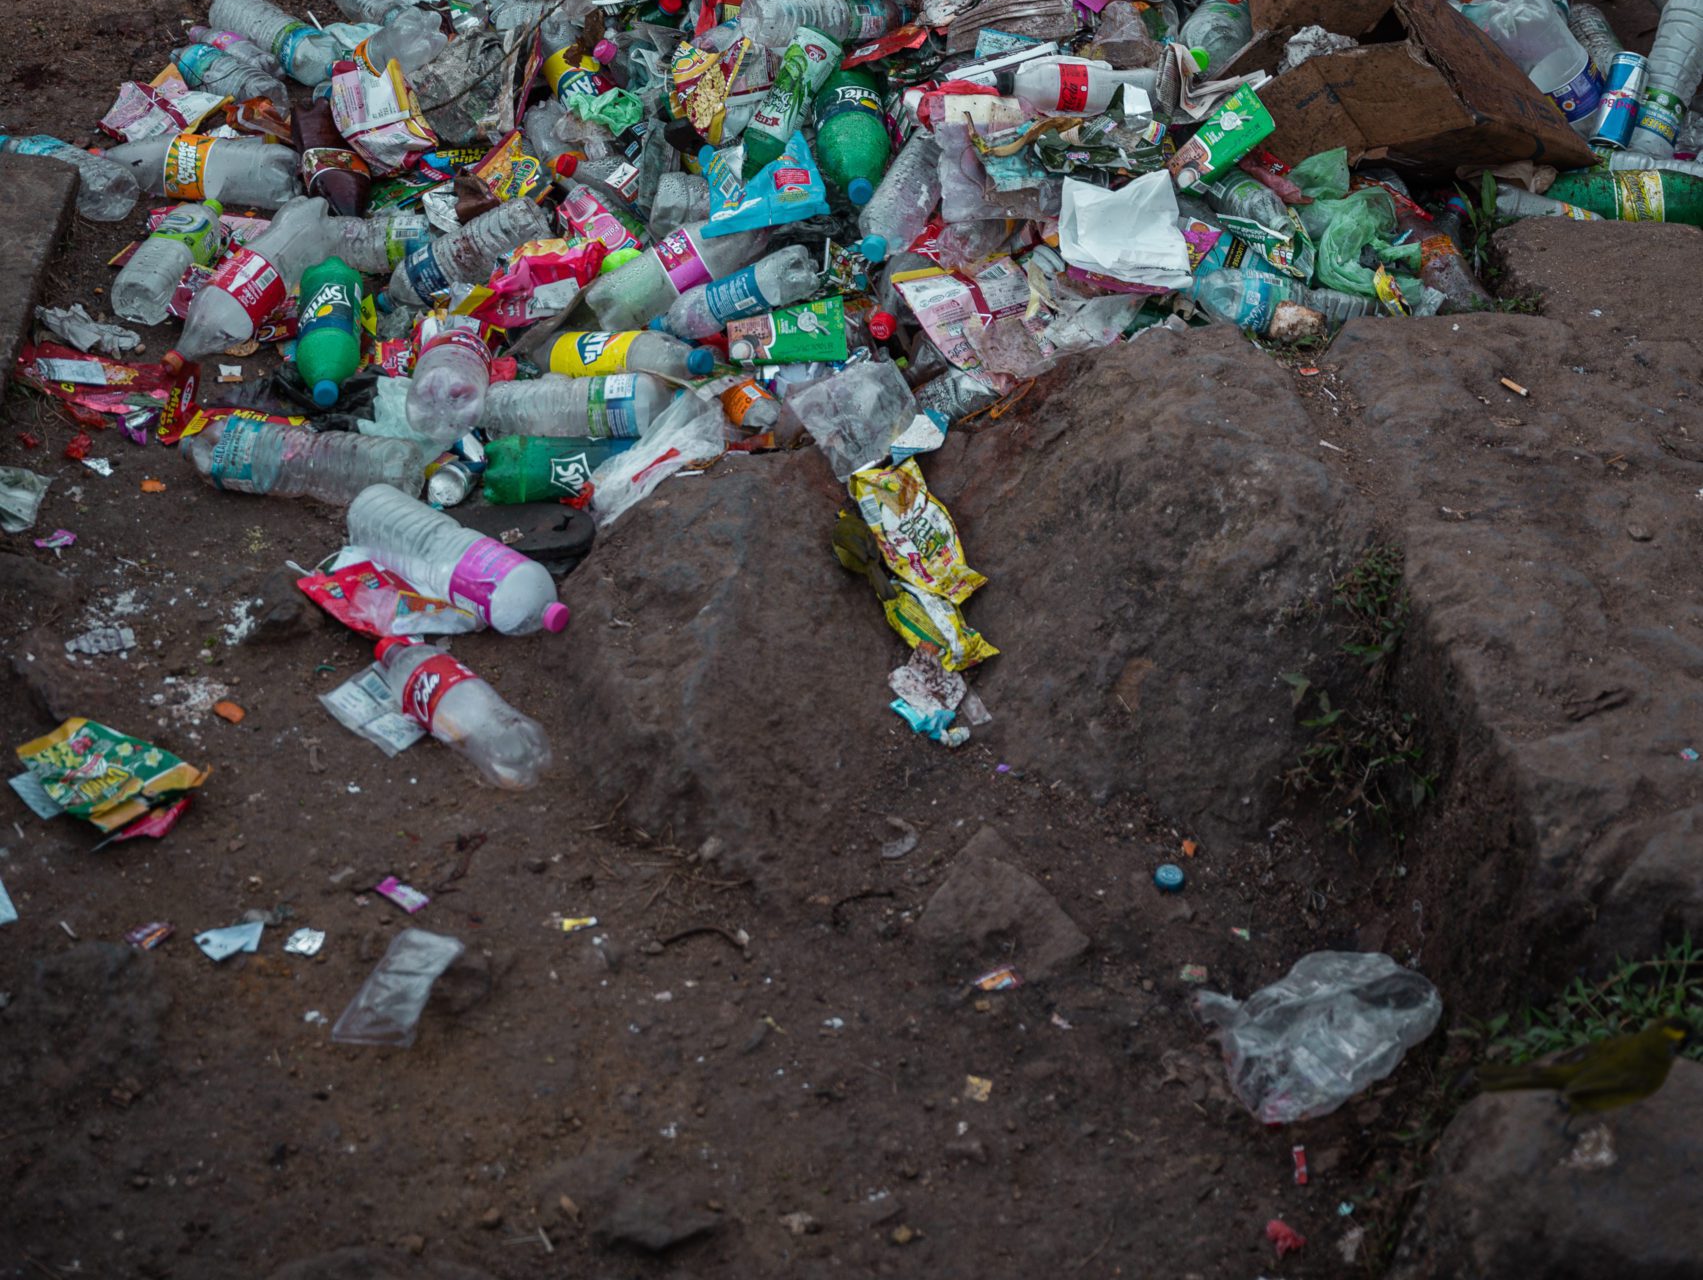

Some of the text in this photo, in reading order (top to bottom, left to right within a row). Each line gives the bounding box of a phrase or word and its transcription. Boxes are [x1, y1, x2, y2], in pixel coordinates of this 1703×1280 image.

[177, 141, 189, 185] Orange
[186, 144, 197, 182] Crush
[450, 154, 482, 166] Mini
[232, 407, 269, 423] Mini
